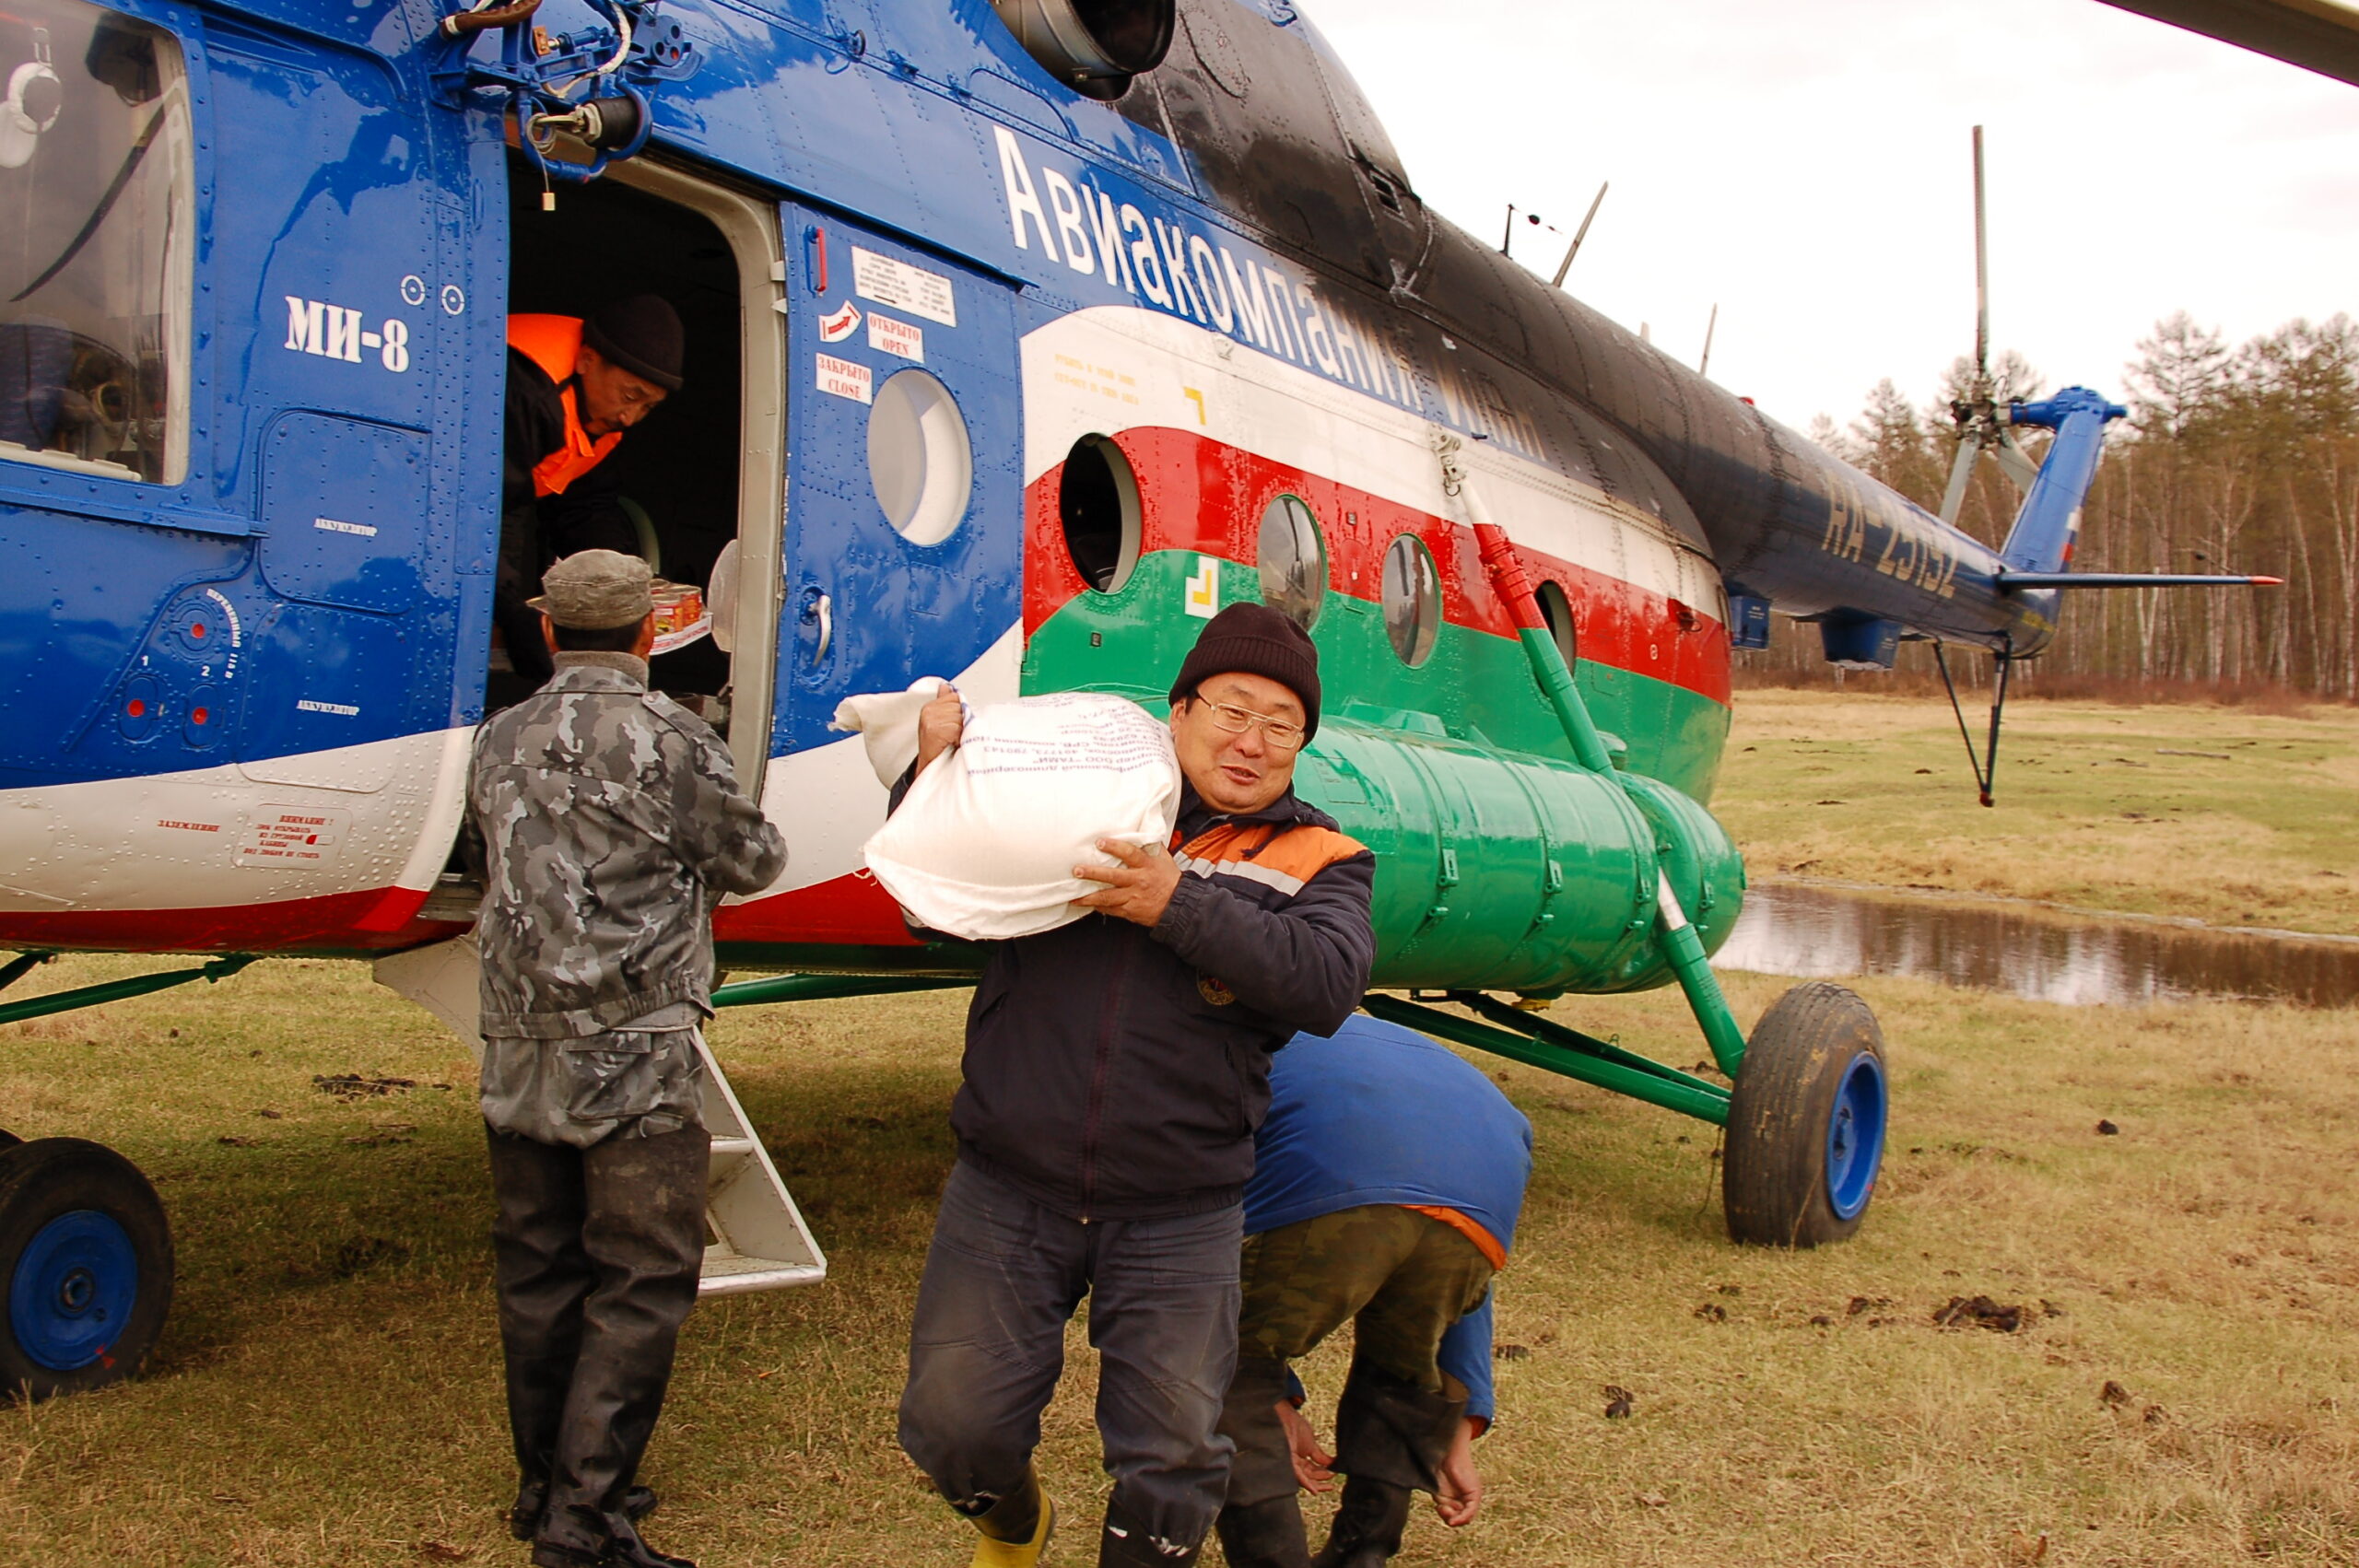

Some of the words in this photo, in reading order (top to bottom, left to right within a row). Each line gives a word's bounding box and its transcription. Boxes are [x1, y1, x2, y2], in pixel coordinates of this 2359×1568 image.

[284, 295, 410, 373] МИ-8
[869, 315, 920, 342] ОТКРЫТО
[882, 338, 910, 356] OPEN
[818, 356, 870, 383] ЗАКРЫТО
[828, 379, 862, 399] CLOSE
[141, 655, 149, 666] 1
[201, 665, 210, 677] 2
